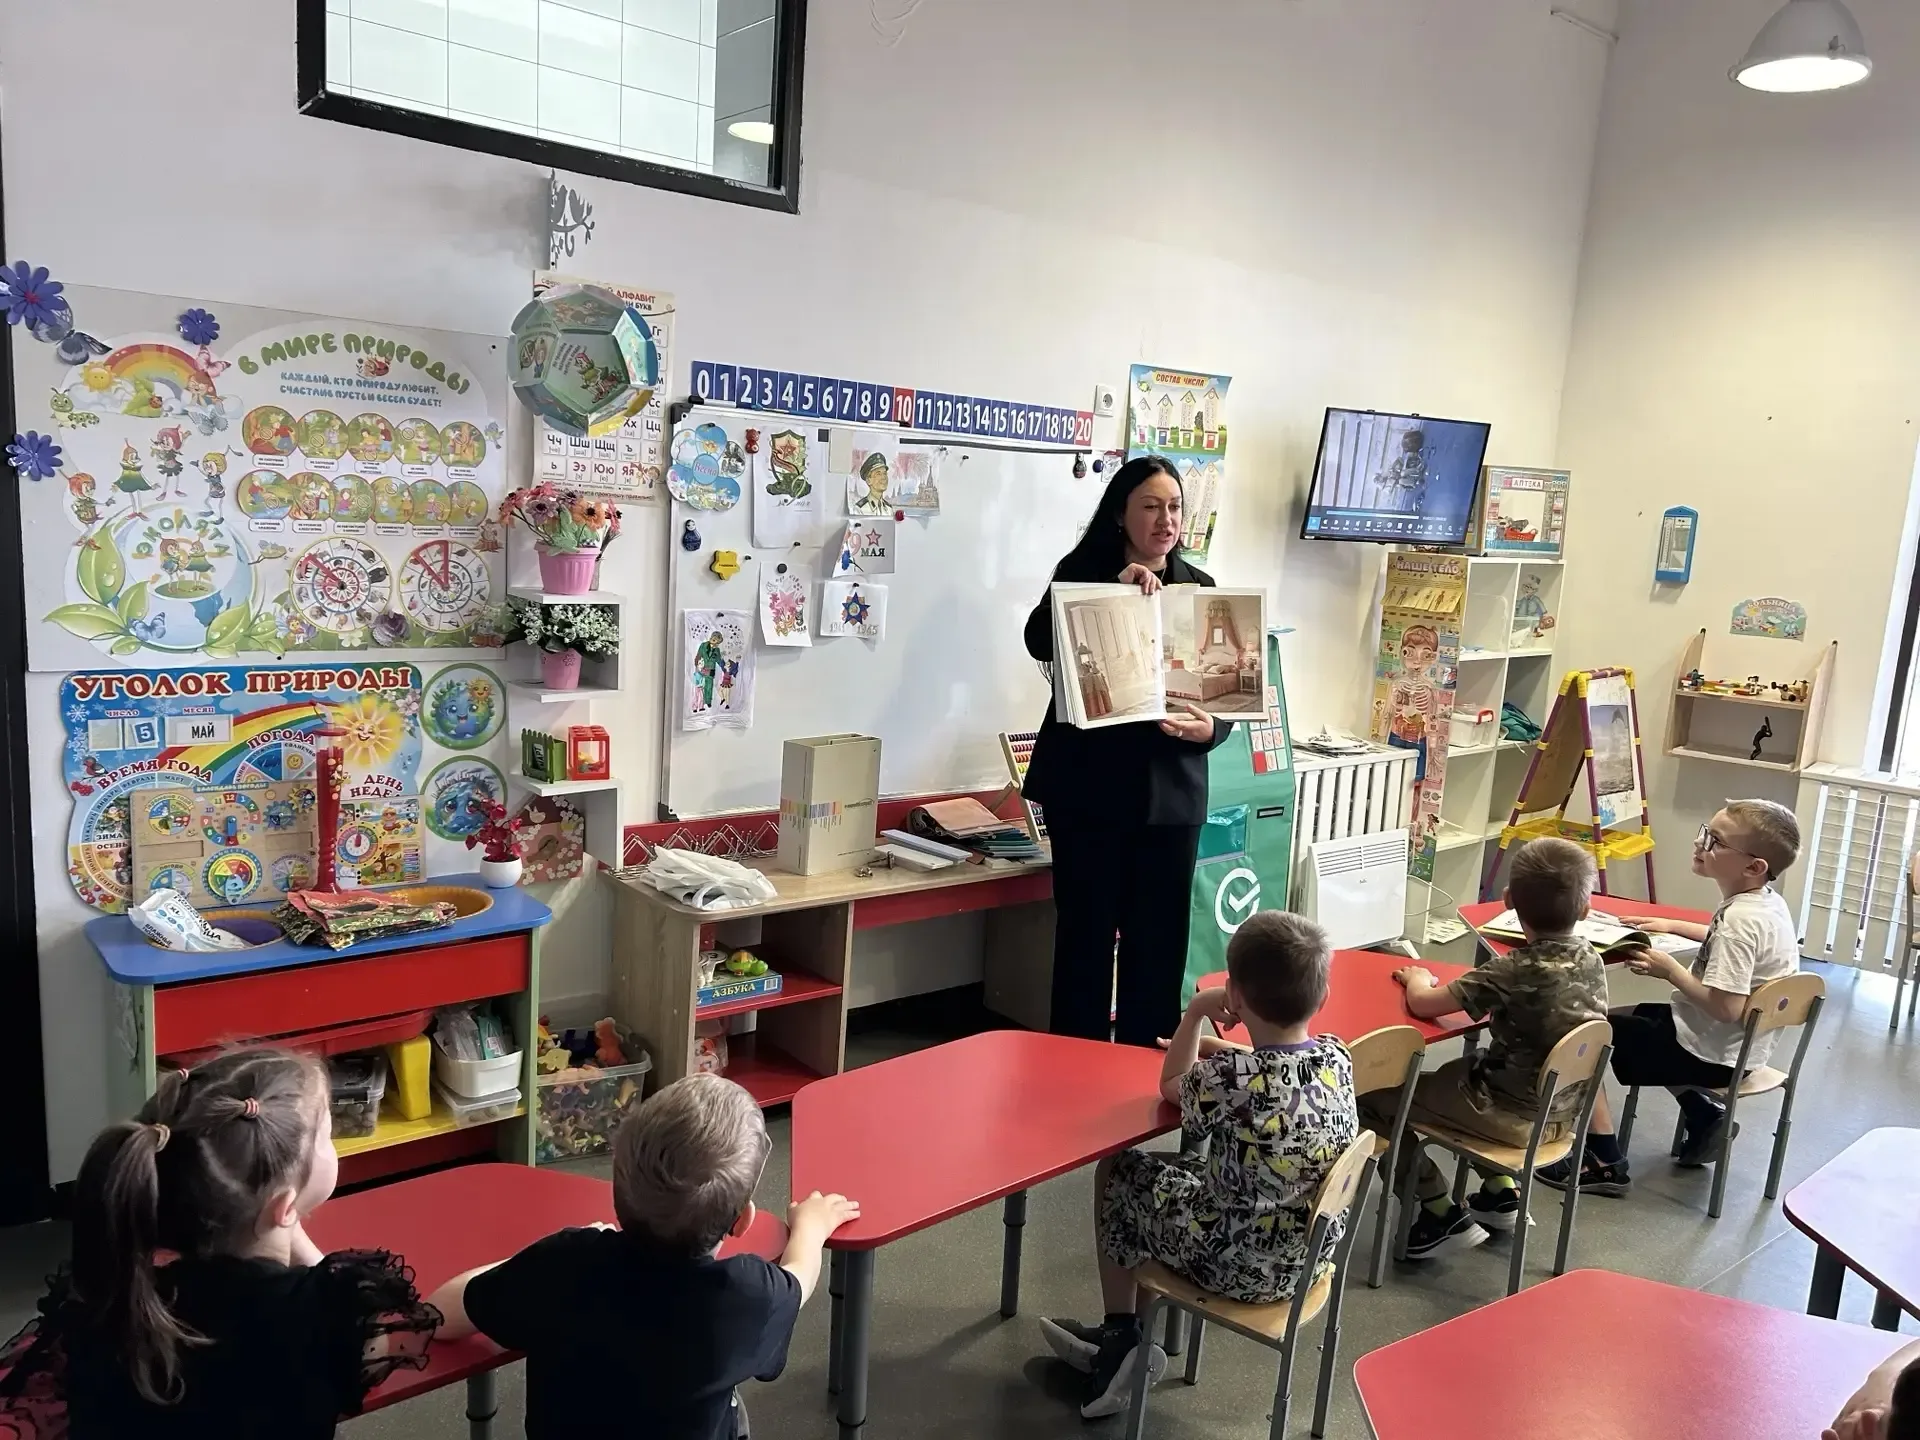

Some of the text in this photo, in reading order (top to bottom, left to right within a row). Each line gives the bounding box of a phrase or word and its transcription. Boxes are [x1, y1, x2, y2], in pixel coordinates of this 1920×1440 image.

[616, 291, 656, 304] АЛФАВИТ
[635, 302, 652, 311] БУКВ
[238, 332, 470, 395] В МИРЕ ПРИРОДЫ
[333, 377, 353, 387] КТО
[356, 379, 402, 392] ПРИРОДУ
[1155, 373, 1205, 387] СОСТАВ ЧИСЛА
[280, 385, 334, 398] СЧАСТЛИВ
[376, 393, 406, 405] ВЕСЕЛ
[407, 396, 442, 408] БУДЕТ!
[697, 370, 1092, 442] 0 1 2 3 4 5 6 7 8 9 10 11 12 13 14 15 16 17 18 19 20
[646, 420, 661, 432] Цц
[547, 434, 562, 445] Чч
[570, 437, 590, 448] Шш
[594, 439, 615, 452] Щщ
[573, 461, 586, 472] Ээ
[594, 464, 615, 475] Юю
[622, 466, 635, 476] Яя
[1513, 479, 1541, 488] АПТЕКА
[861, 547, 885, 557] МАЯ
[1396, 560, 1460, 576] НАШЕ ТЕЛО
[1747, 600, 1796, 613] БОЛЬНИЦА
[72, 667, 412, 700] УГОЛОК ПРИРОДЫ
[105, 706, 216, 718] ЧИСЛО МЕСЯЦ
[140, 722, 215, 739] 5 МАЙ
[247, 729, 315, 750] ПОГОДА
[97, 759, 213, 790] ВРЕМЯ ГОДА
[364, 774, 404, 791] ДЕНЬ
[350, 786, 401, 798] НЕДЕ
[97, 842, 129, 850] ОСЕНЬ
[712, 983, 756, 998] АЗБУКА
